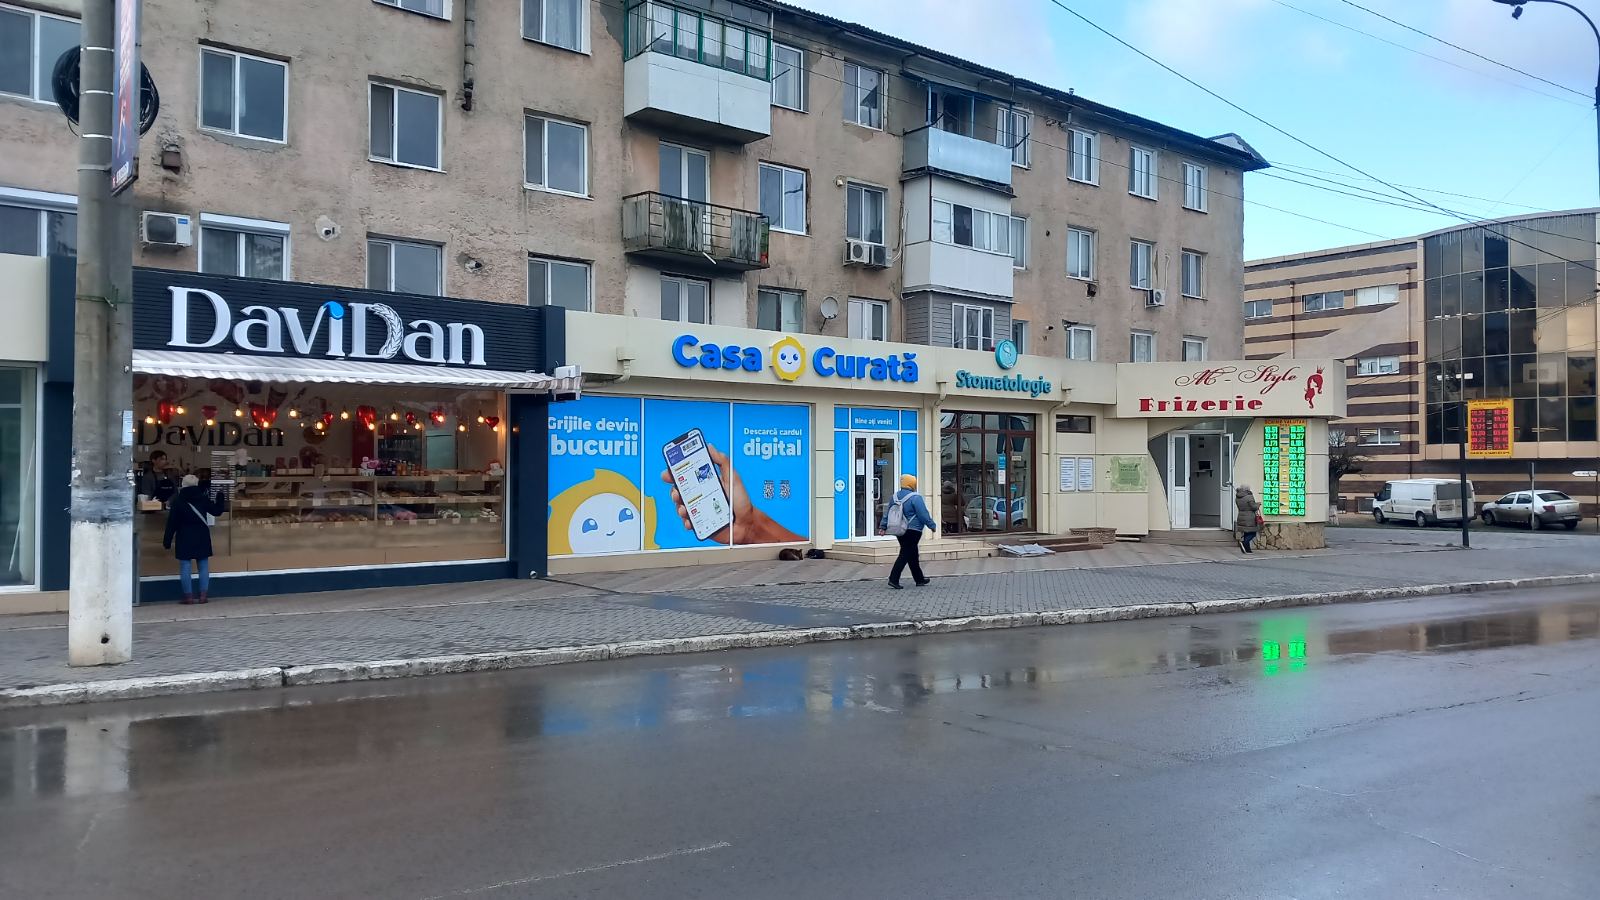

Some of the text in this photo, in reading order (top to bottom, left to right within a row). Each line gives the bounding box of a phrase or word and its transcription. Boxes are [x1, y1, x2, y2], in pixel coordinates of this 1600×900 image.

[166, 285, 486, 366] DaviDan
[671, 334, 919, 383] Casa Curată
[956, 369, 1052, 397] Stomatologie
[1238, 364, 1300, 394] Style
[1139, 396, 1263, 412] Frizerie
[136, 420, 284, 447] DaviDan
[548, 416, 639, 433] Grijile devin
[744, 427, 802, 436] Descarcă cardul
[551, 433, 638, 456] bucurii
[743, 437, 802, 460] digital
